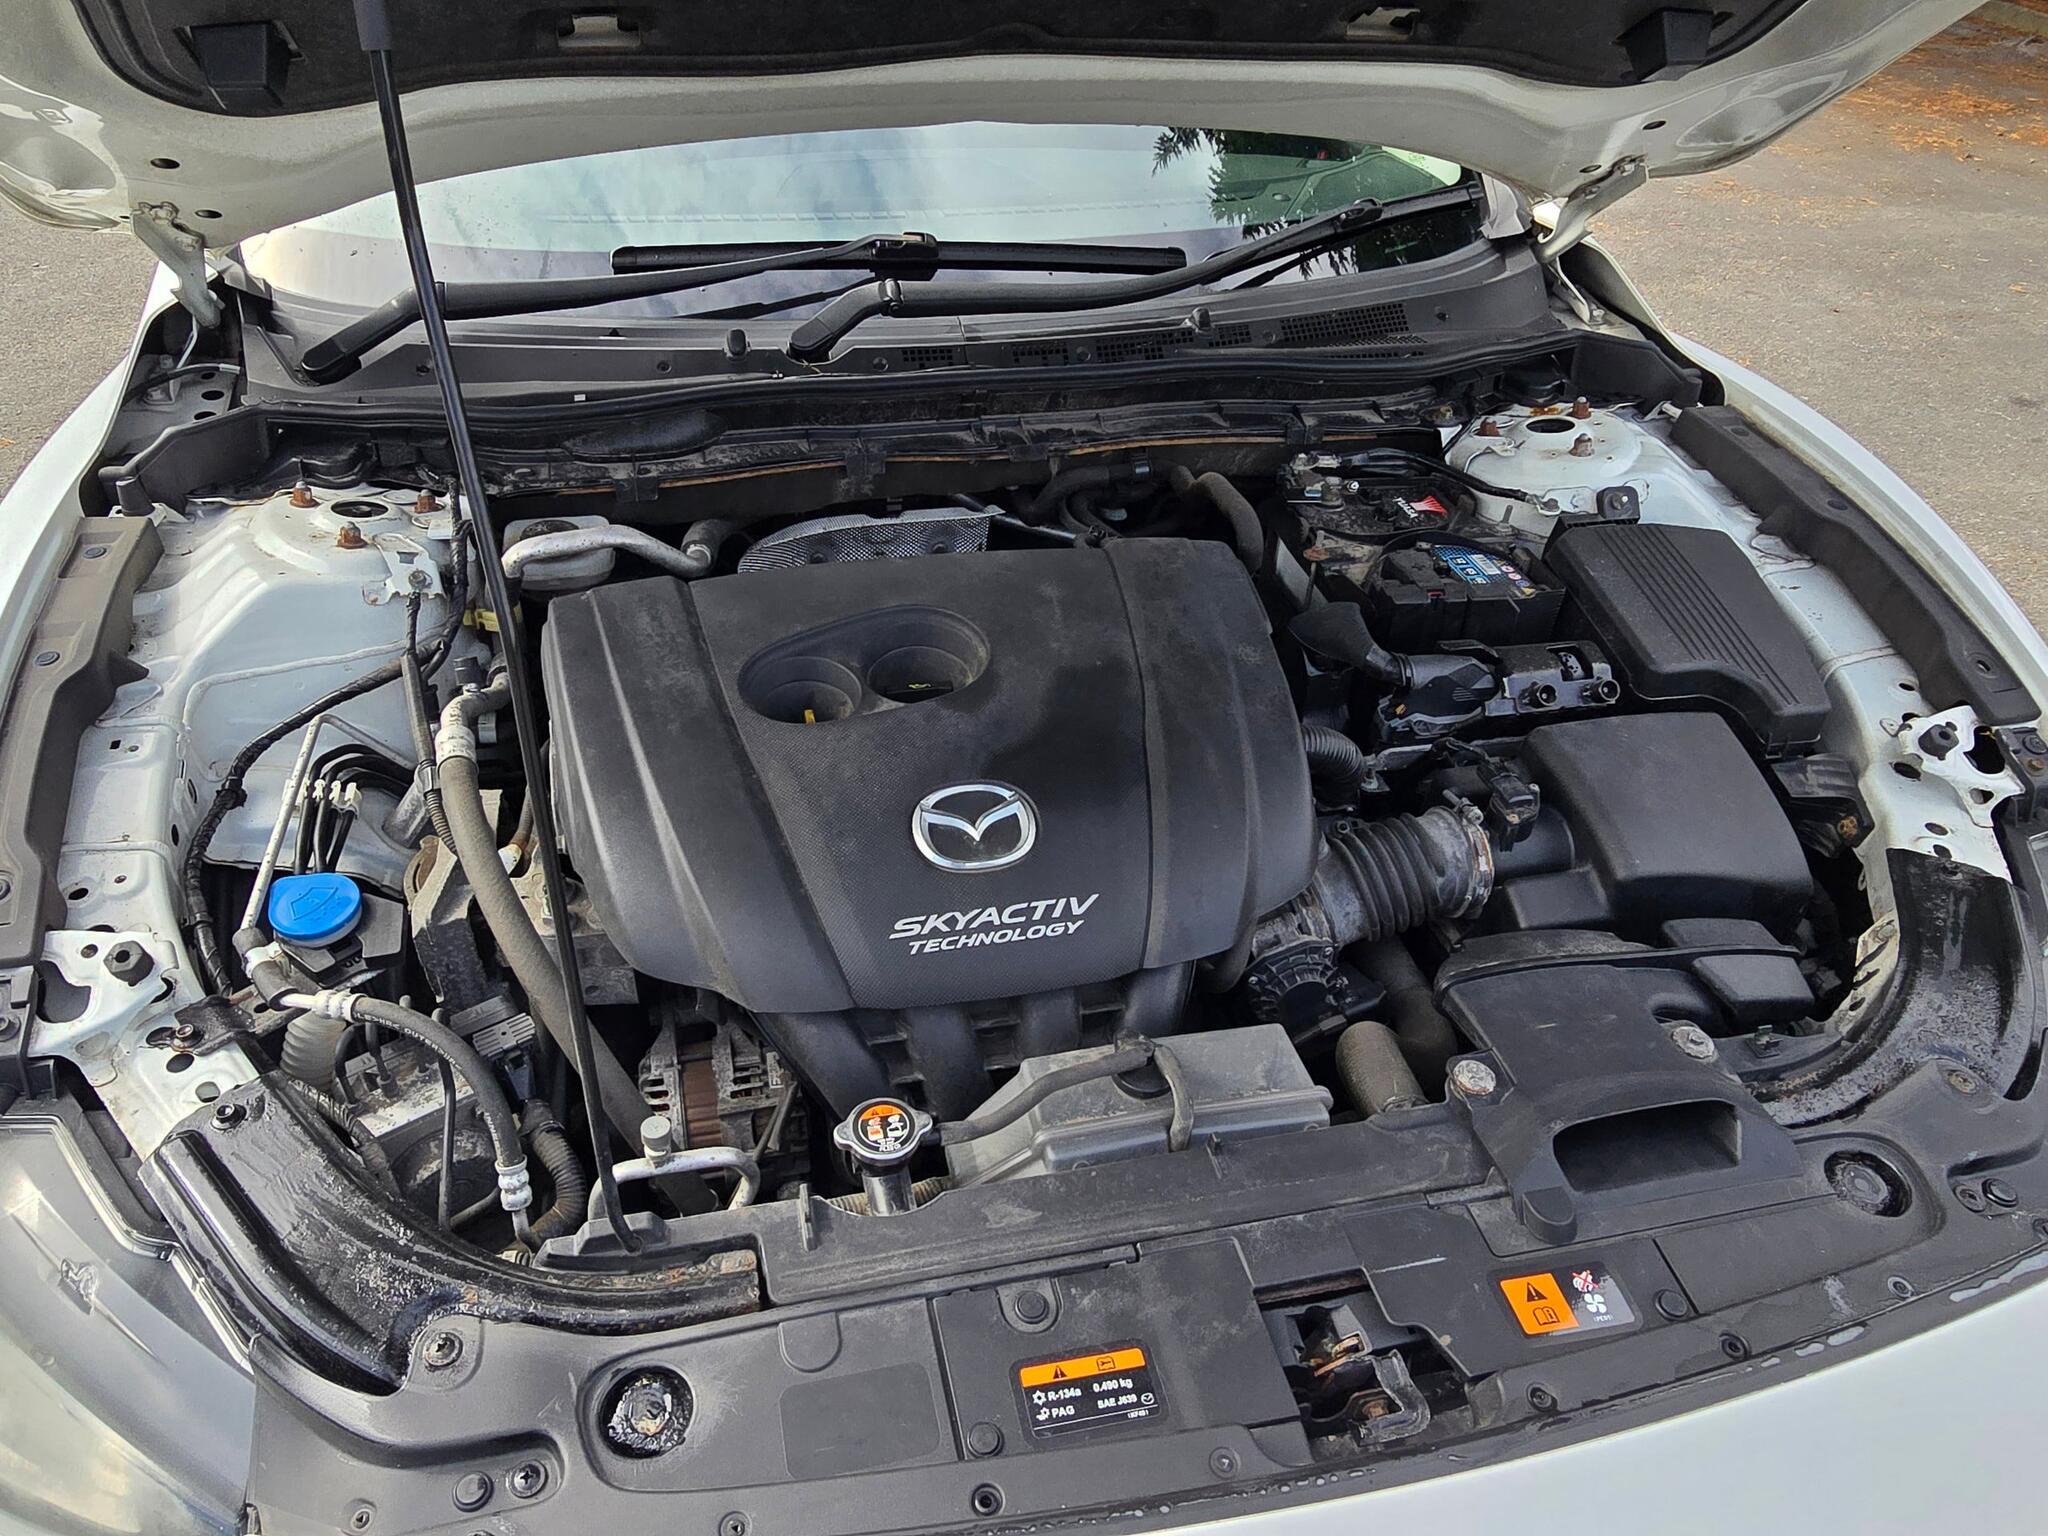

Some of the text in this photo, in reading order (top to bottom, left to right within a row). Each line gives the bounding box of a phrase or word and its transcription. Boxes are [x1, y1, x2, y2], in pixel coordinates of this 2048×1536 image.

[889, 894, 1099, 939] SKYACTIV
[909, 920, 1085, 955] TECHNOLOGY
[1047, 1387, 1082, 1401] R-134a
[1119, 1377, 1133, 1389] kg
[1051, 1405, 1075, 1418] PAG
